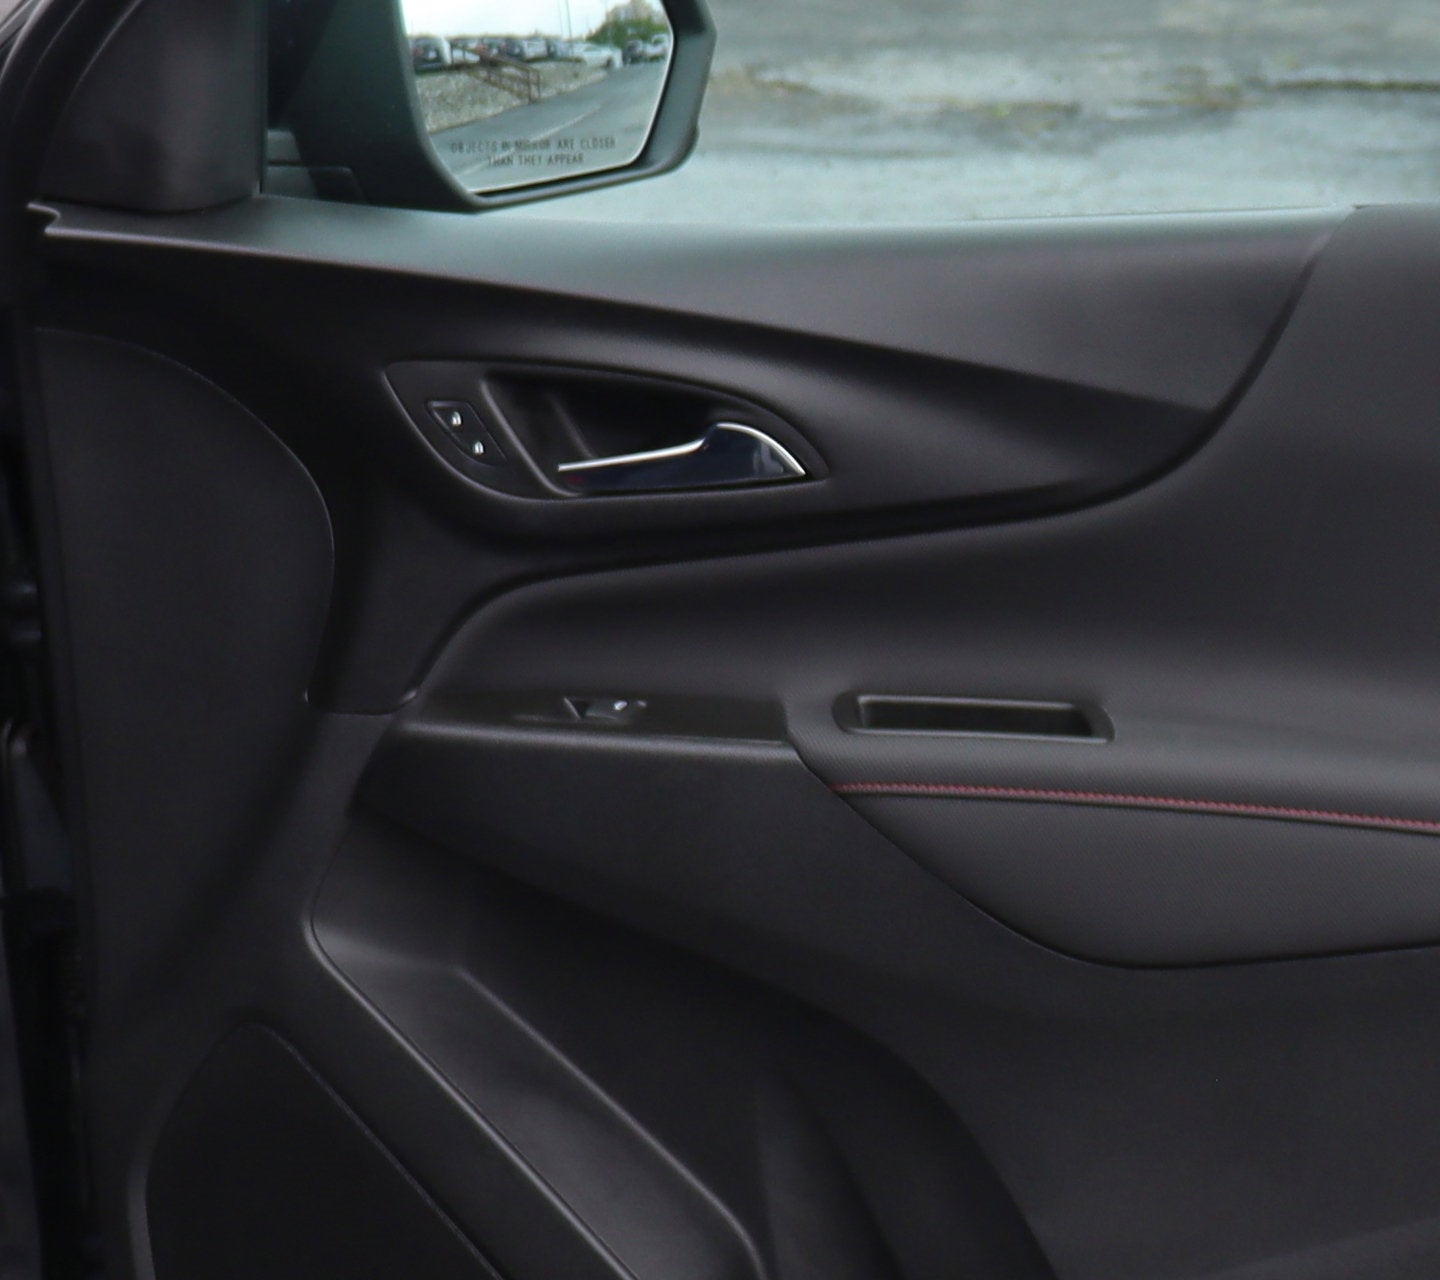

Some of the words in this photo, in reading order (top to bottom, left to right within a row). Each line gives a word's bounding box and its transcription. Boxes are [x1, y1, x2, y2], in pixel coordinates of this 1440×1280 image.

[450, 139, 498, 154] OBJECTS
[558, 137, 576, 150] ARE
[580, 136, 617, 150] CLOSER
[487, 155, 514, 167] THAN
[517, 154, 544, 167] THEY
[547, 153, 585, 166] APPEAR
